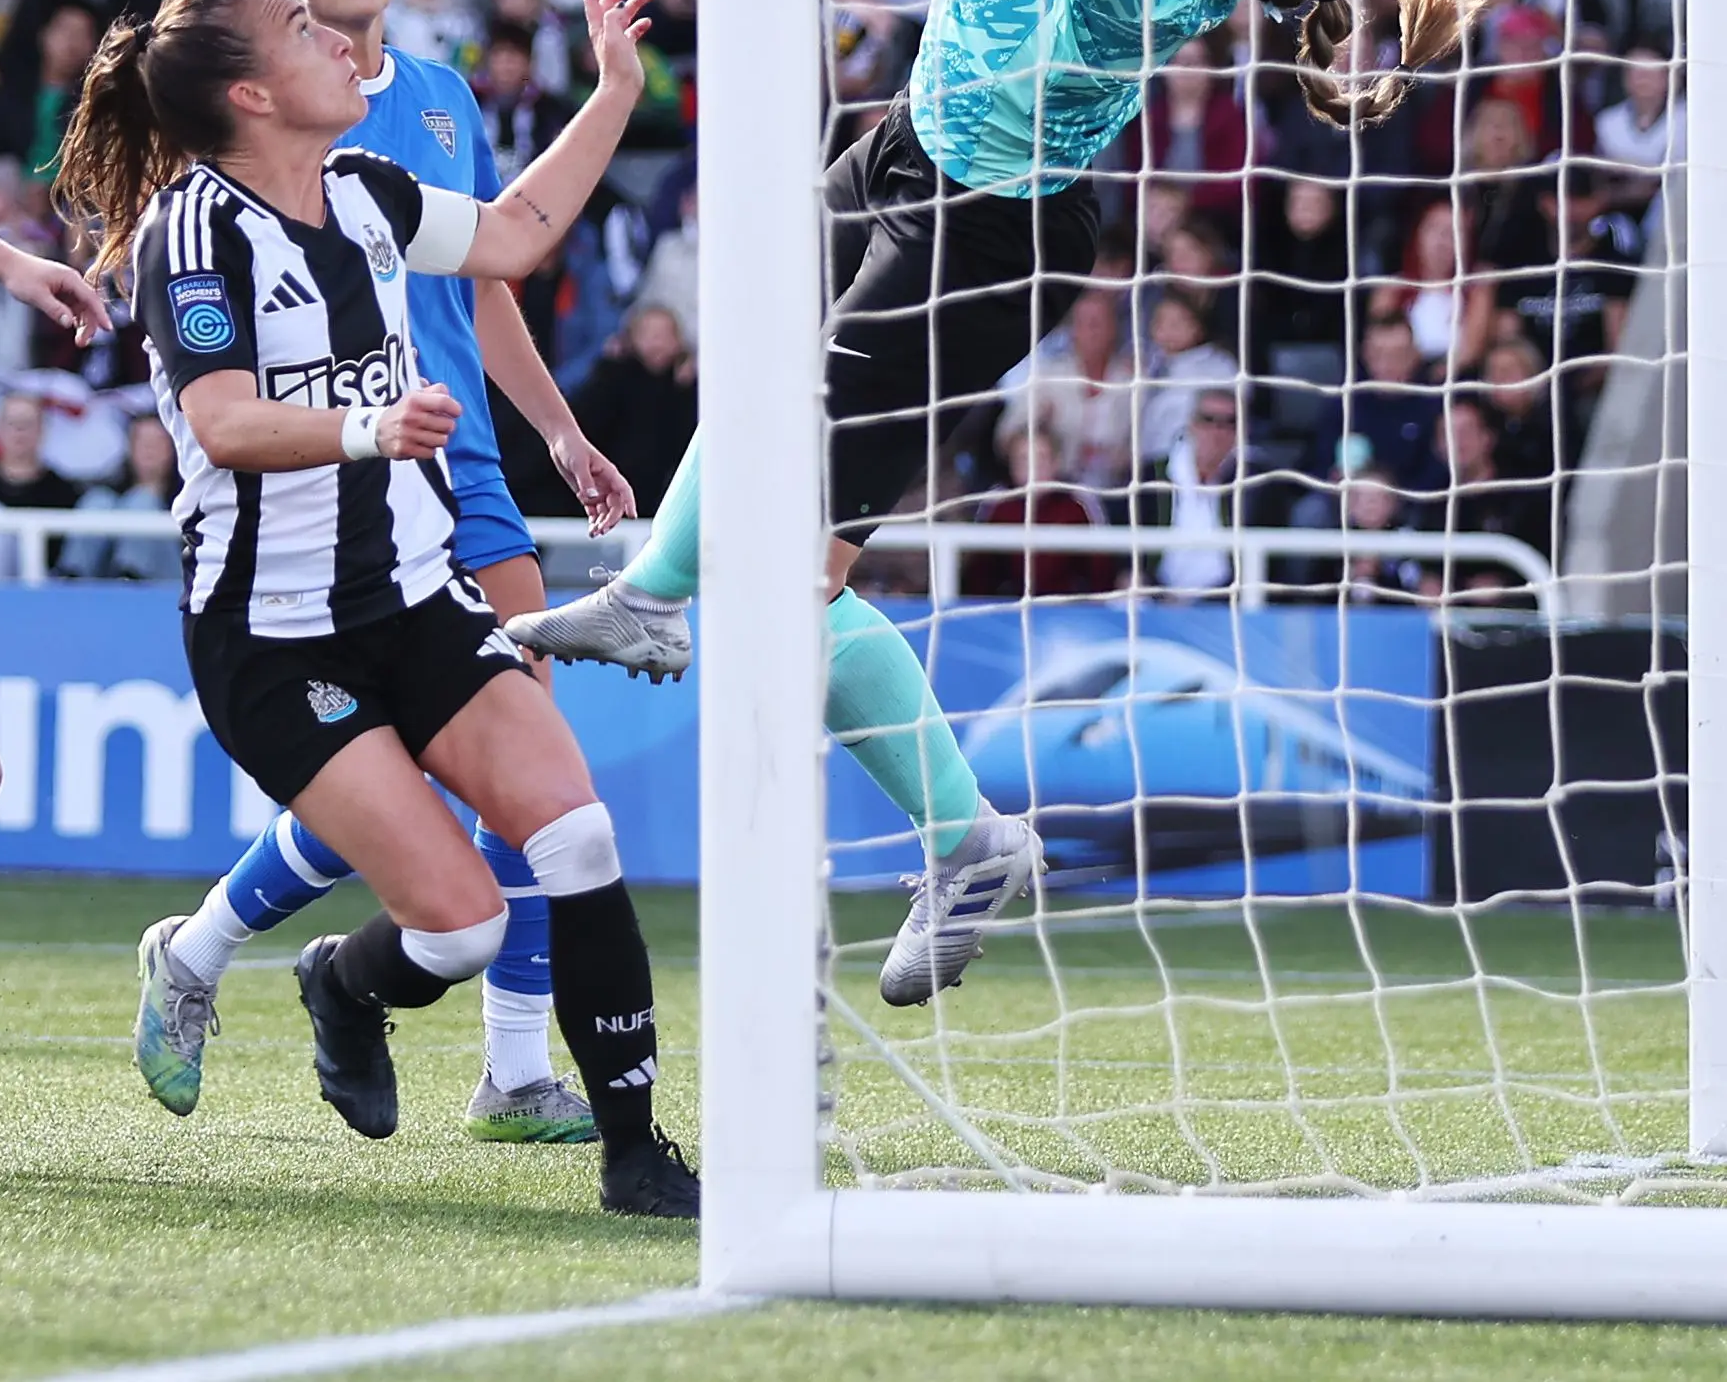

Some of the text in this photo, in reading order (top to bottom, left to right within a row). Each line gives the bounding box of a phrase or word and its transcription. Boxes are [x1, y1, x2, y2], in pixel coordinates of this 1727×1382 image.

[182, 280, 220, 291] BARCLAYS
[176, 287, 222, 302] WOMEN'S
[489, 1106, 543, 1123] NEMESIS
